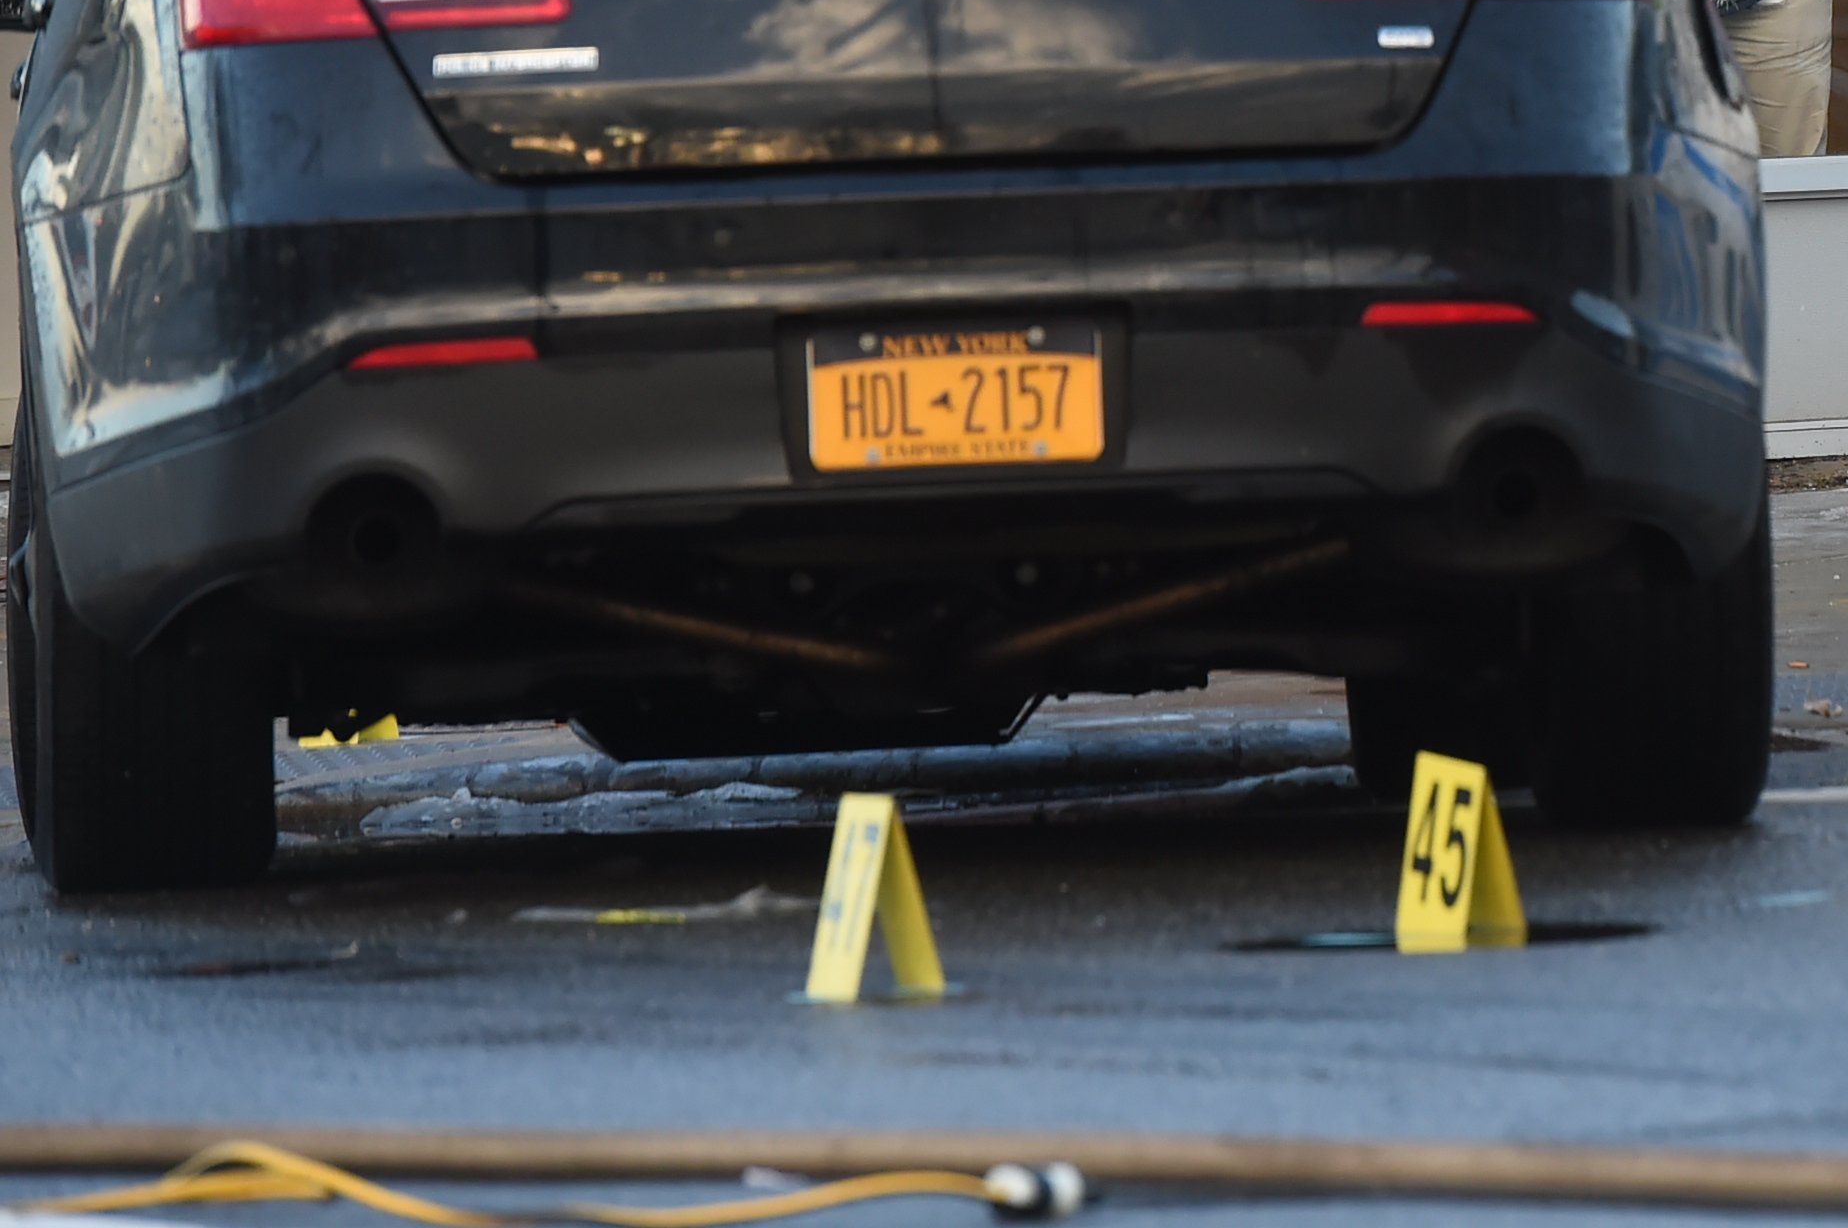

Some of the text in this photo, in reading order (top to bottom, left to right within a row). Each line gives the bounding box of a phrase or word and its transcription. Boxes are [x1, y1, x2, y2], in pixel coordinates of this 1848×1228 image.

[882, 331, 1029, 358] NEW YORK
[839, 364, 1072, 441] HDL 2157
[1412, 782, 1471, 909] 45
